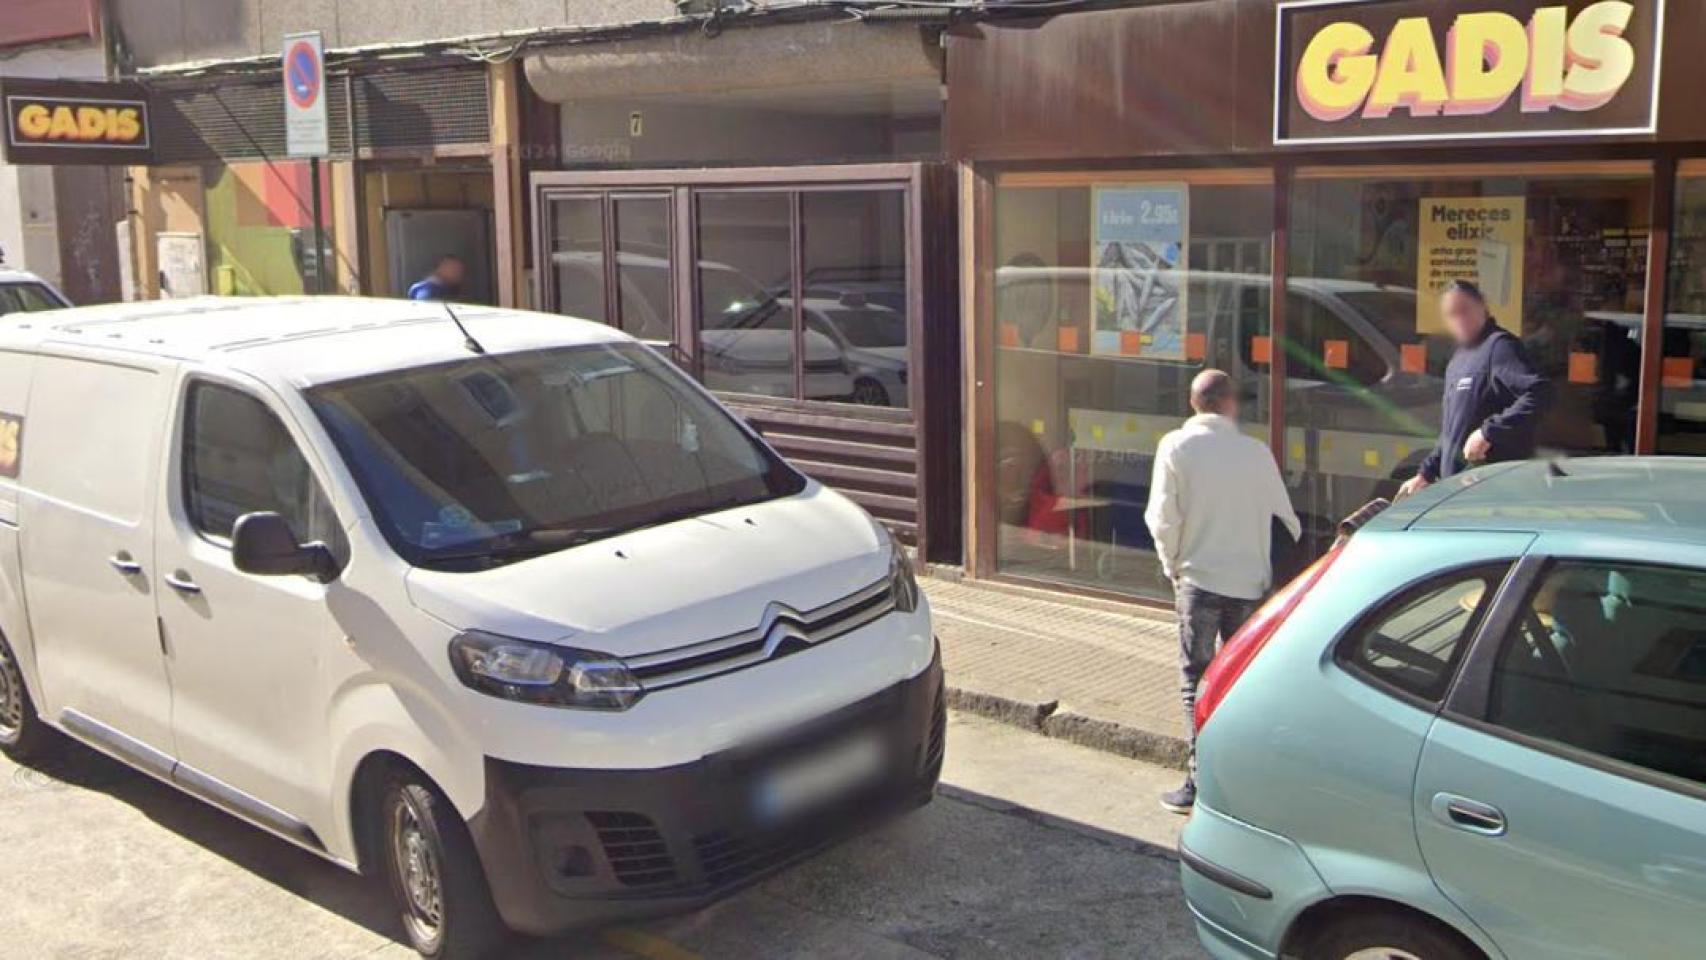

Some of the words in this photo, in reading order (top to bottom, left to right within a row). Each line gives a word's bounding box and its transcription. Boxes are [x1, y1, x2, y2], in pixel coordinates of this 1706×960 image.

[1297, 0, 1634, 121] GADIS
[18, 104, 140, 141] GADIS
[1432, 205, 1510, 222] Mereces
